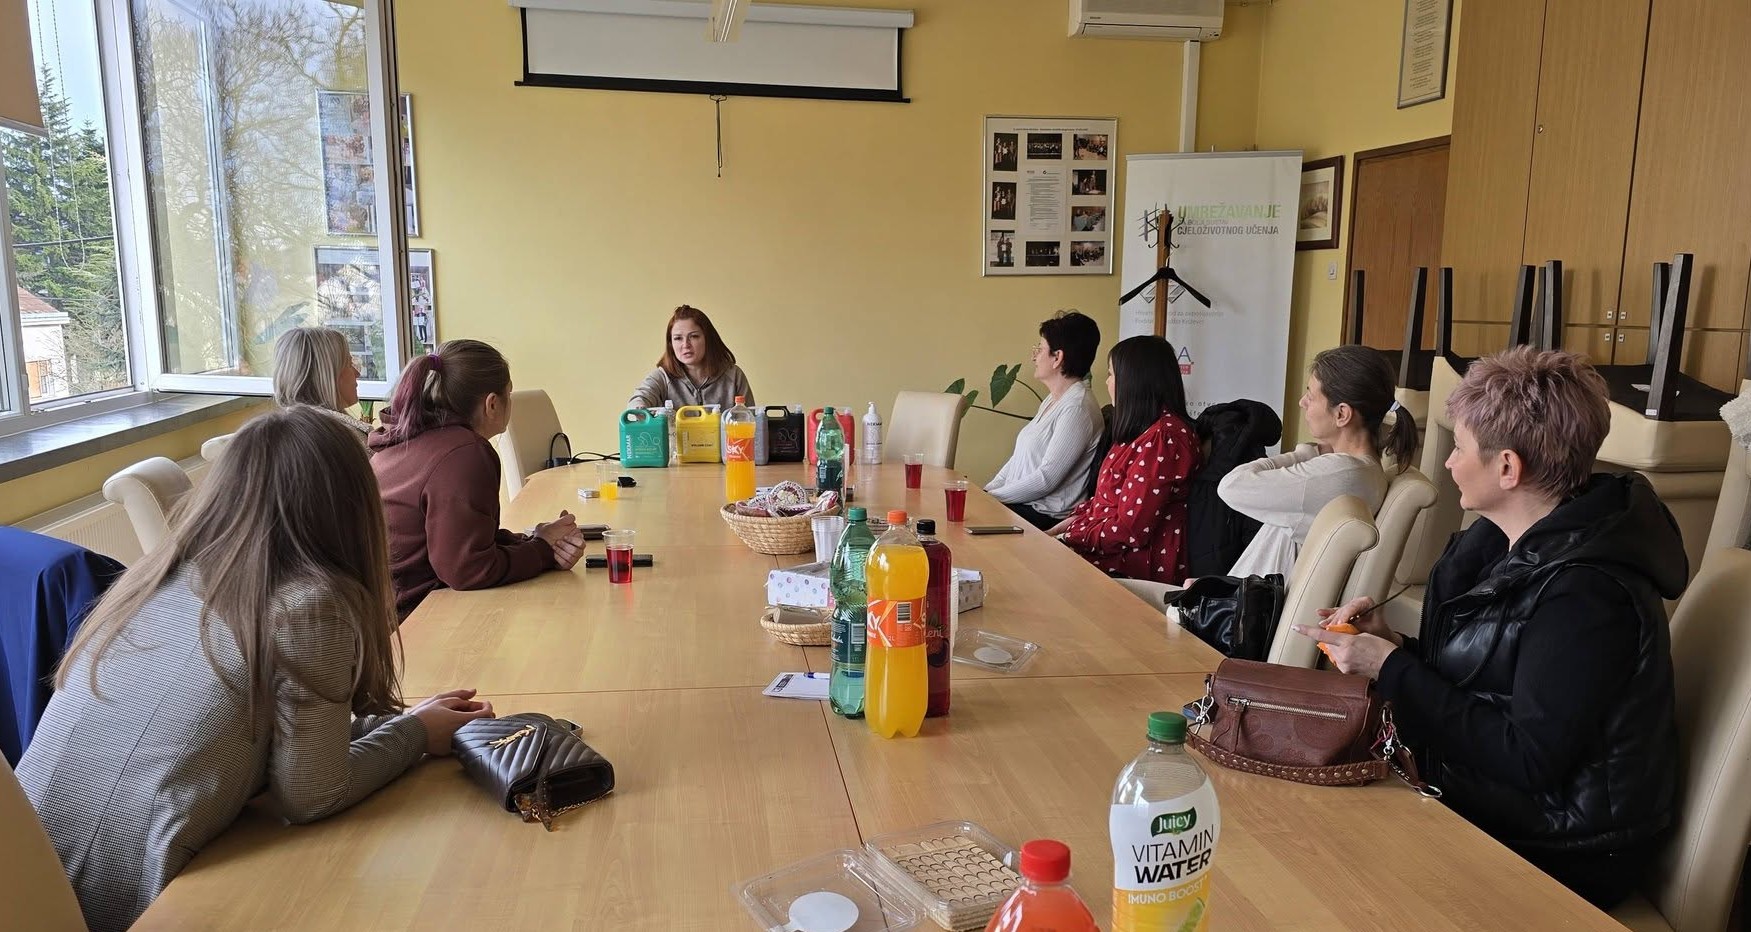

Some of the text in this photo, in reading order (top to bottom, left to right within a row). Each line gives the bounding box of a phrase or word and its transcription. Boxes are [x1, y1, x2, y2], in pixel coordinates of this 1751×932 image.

[1178, 201, 1281, 219] UMREŽAVANJE
[1177, 224, 1279, 235] CJELOŽIVOTNOG UČENJA
[1156, 813, 1192, 833] Juicy
[1132, 824, 1214, 862] VITAMIN
[1135, 848, 1212, 884] WATER
[1128, 874, 1208, 905] IMUNO BOOST
